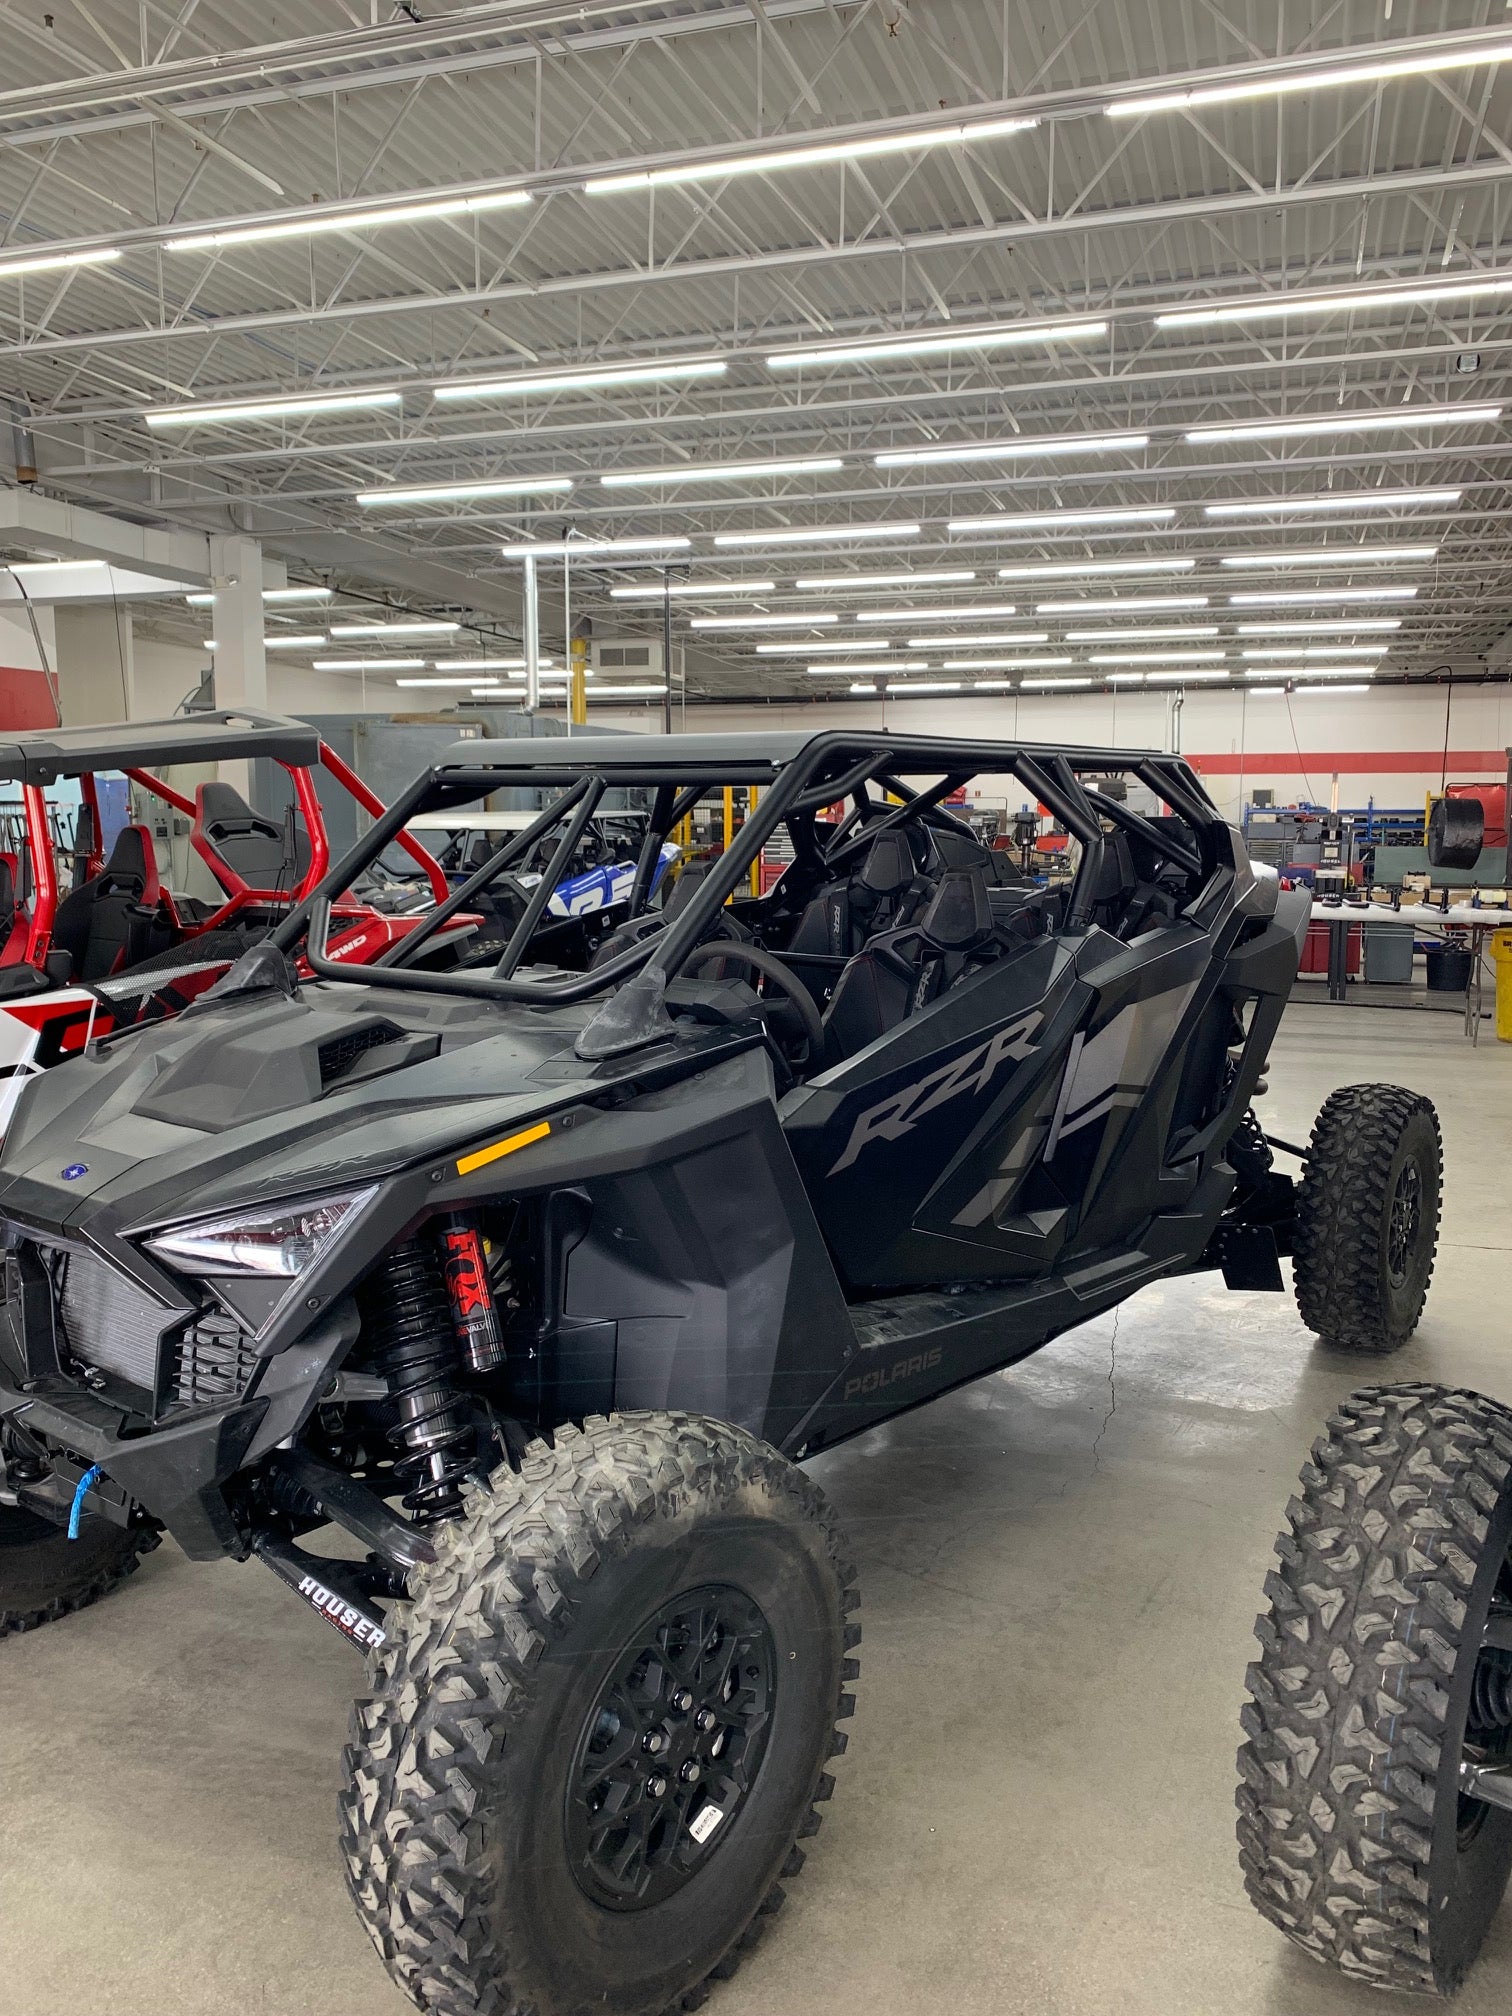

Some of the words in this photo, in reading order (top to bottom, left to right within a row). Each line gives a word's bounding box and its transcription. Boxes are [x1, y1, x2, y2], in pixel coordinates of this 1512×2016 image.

[824, 1009, 1045, 1179] RZR
[445, 1228, 492, 1317] FOX
[844, 1346, 943, 1401] POLARIS
[298, 1576, 386, 1648] HOUSER
